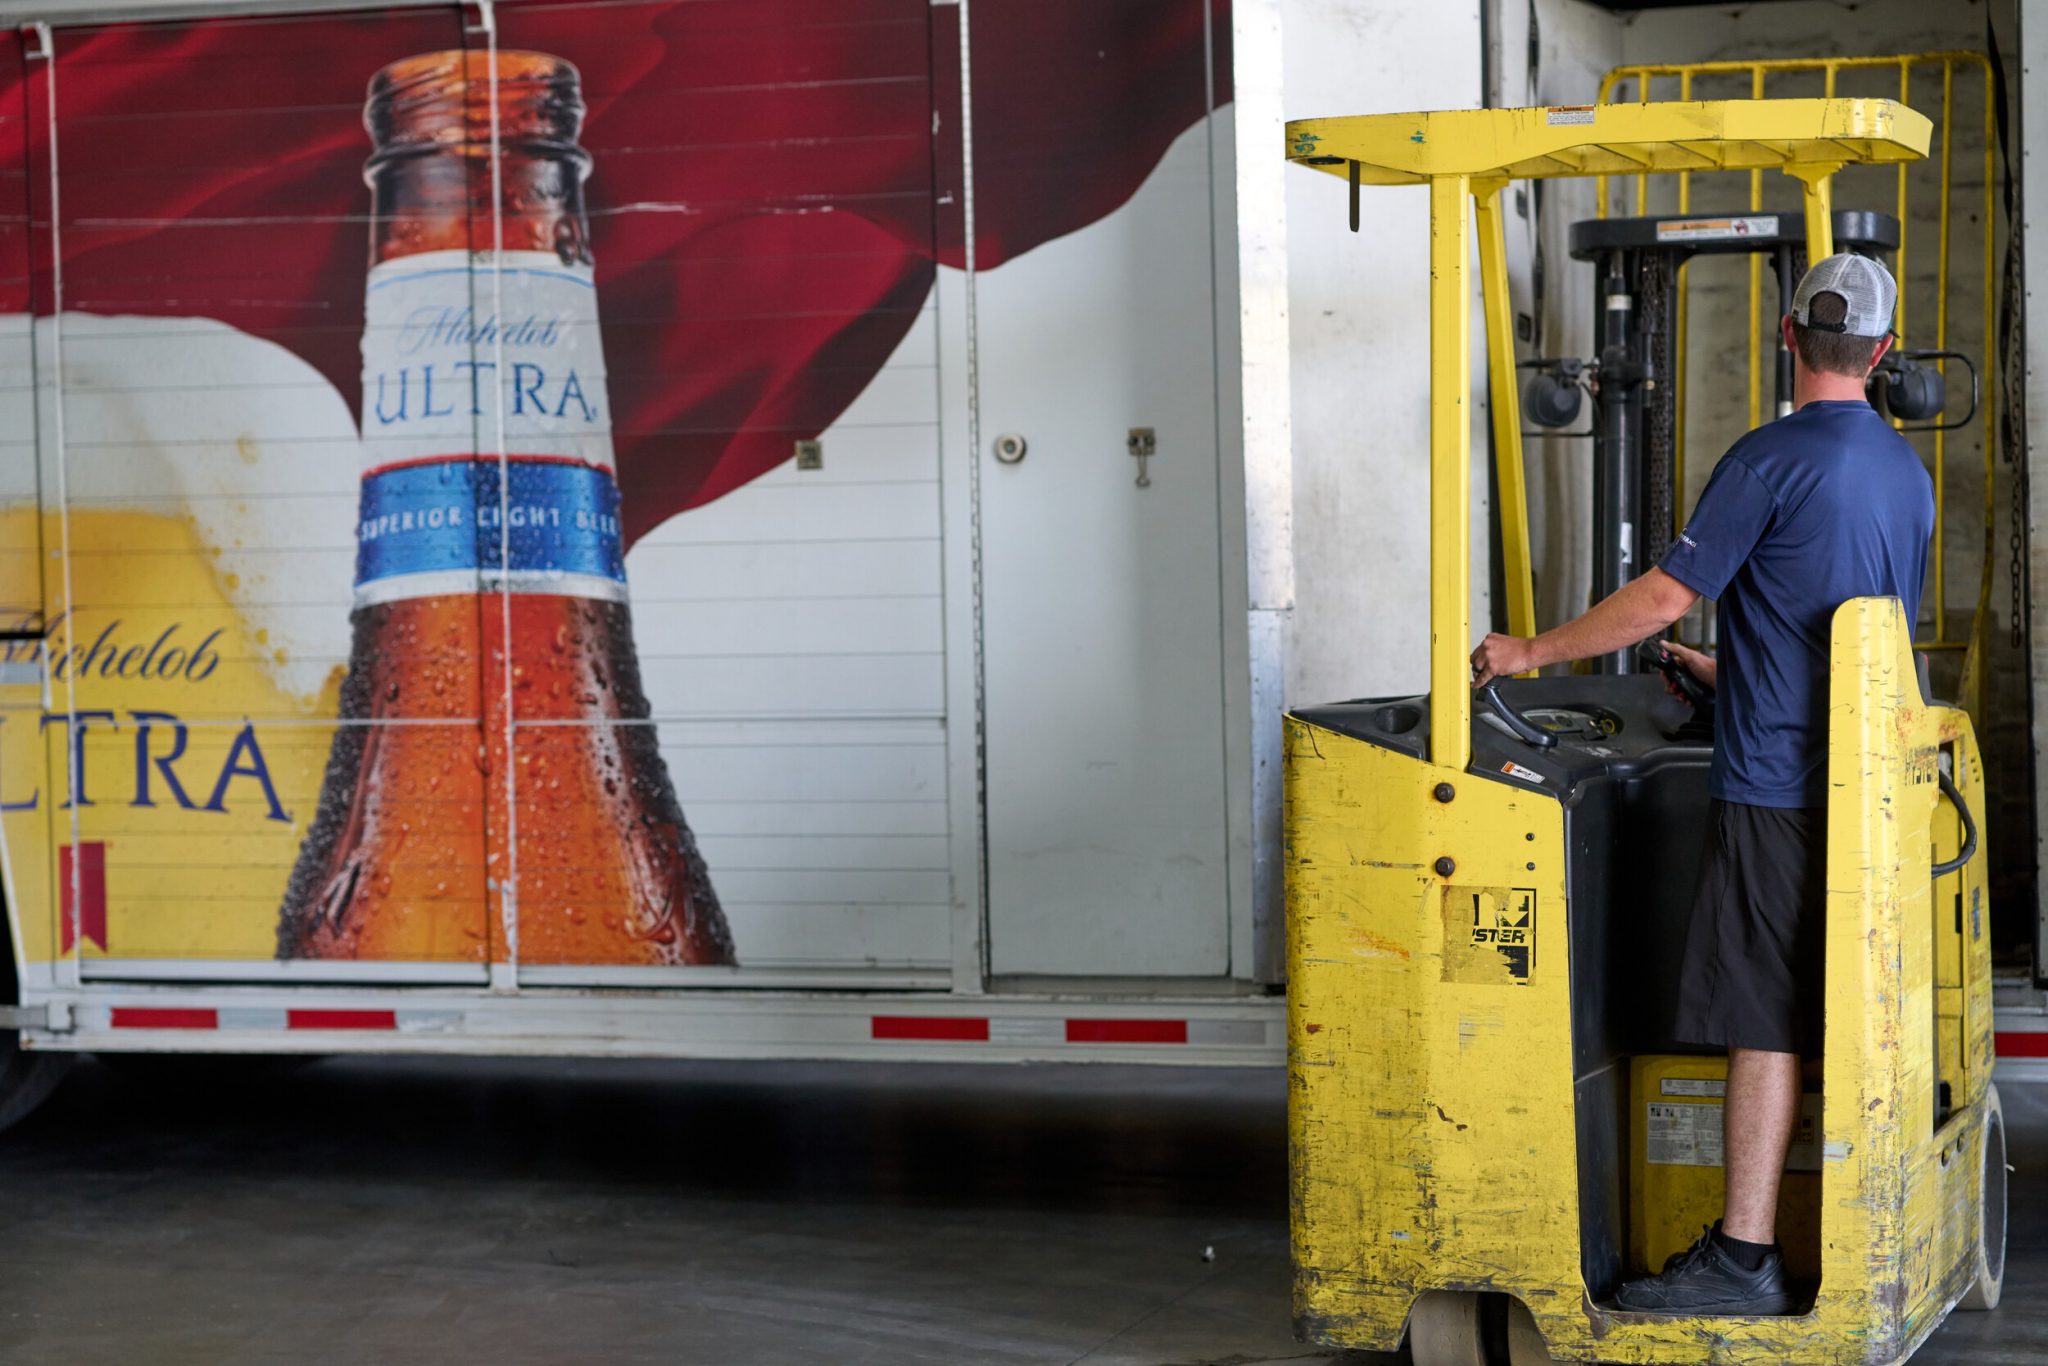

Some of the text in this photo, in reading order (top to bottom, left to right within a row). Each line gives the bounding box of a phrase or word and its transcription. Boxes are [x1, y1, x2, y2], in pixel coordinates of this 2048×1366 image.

[374, 361, 597, 426] ULTRA
[361, 506, 463, 542] SUPERIOR
[477, 506, 561, 528] LIGHT
